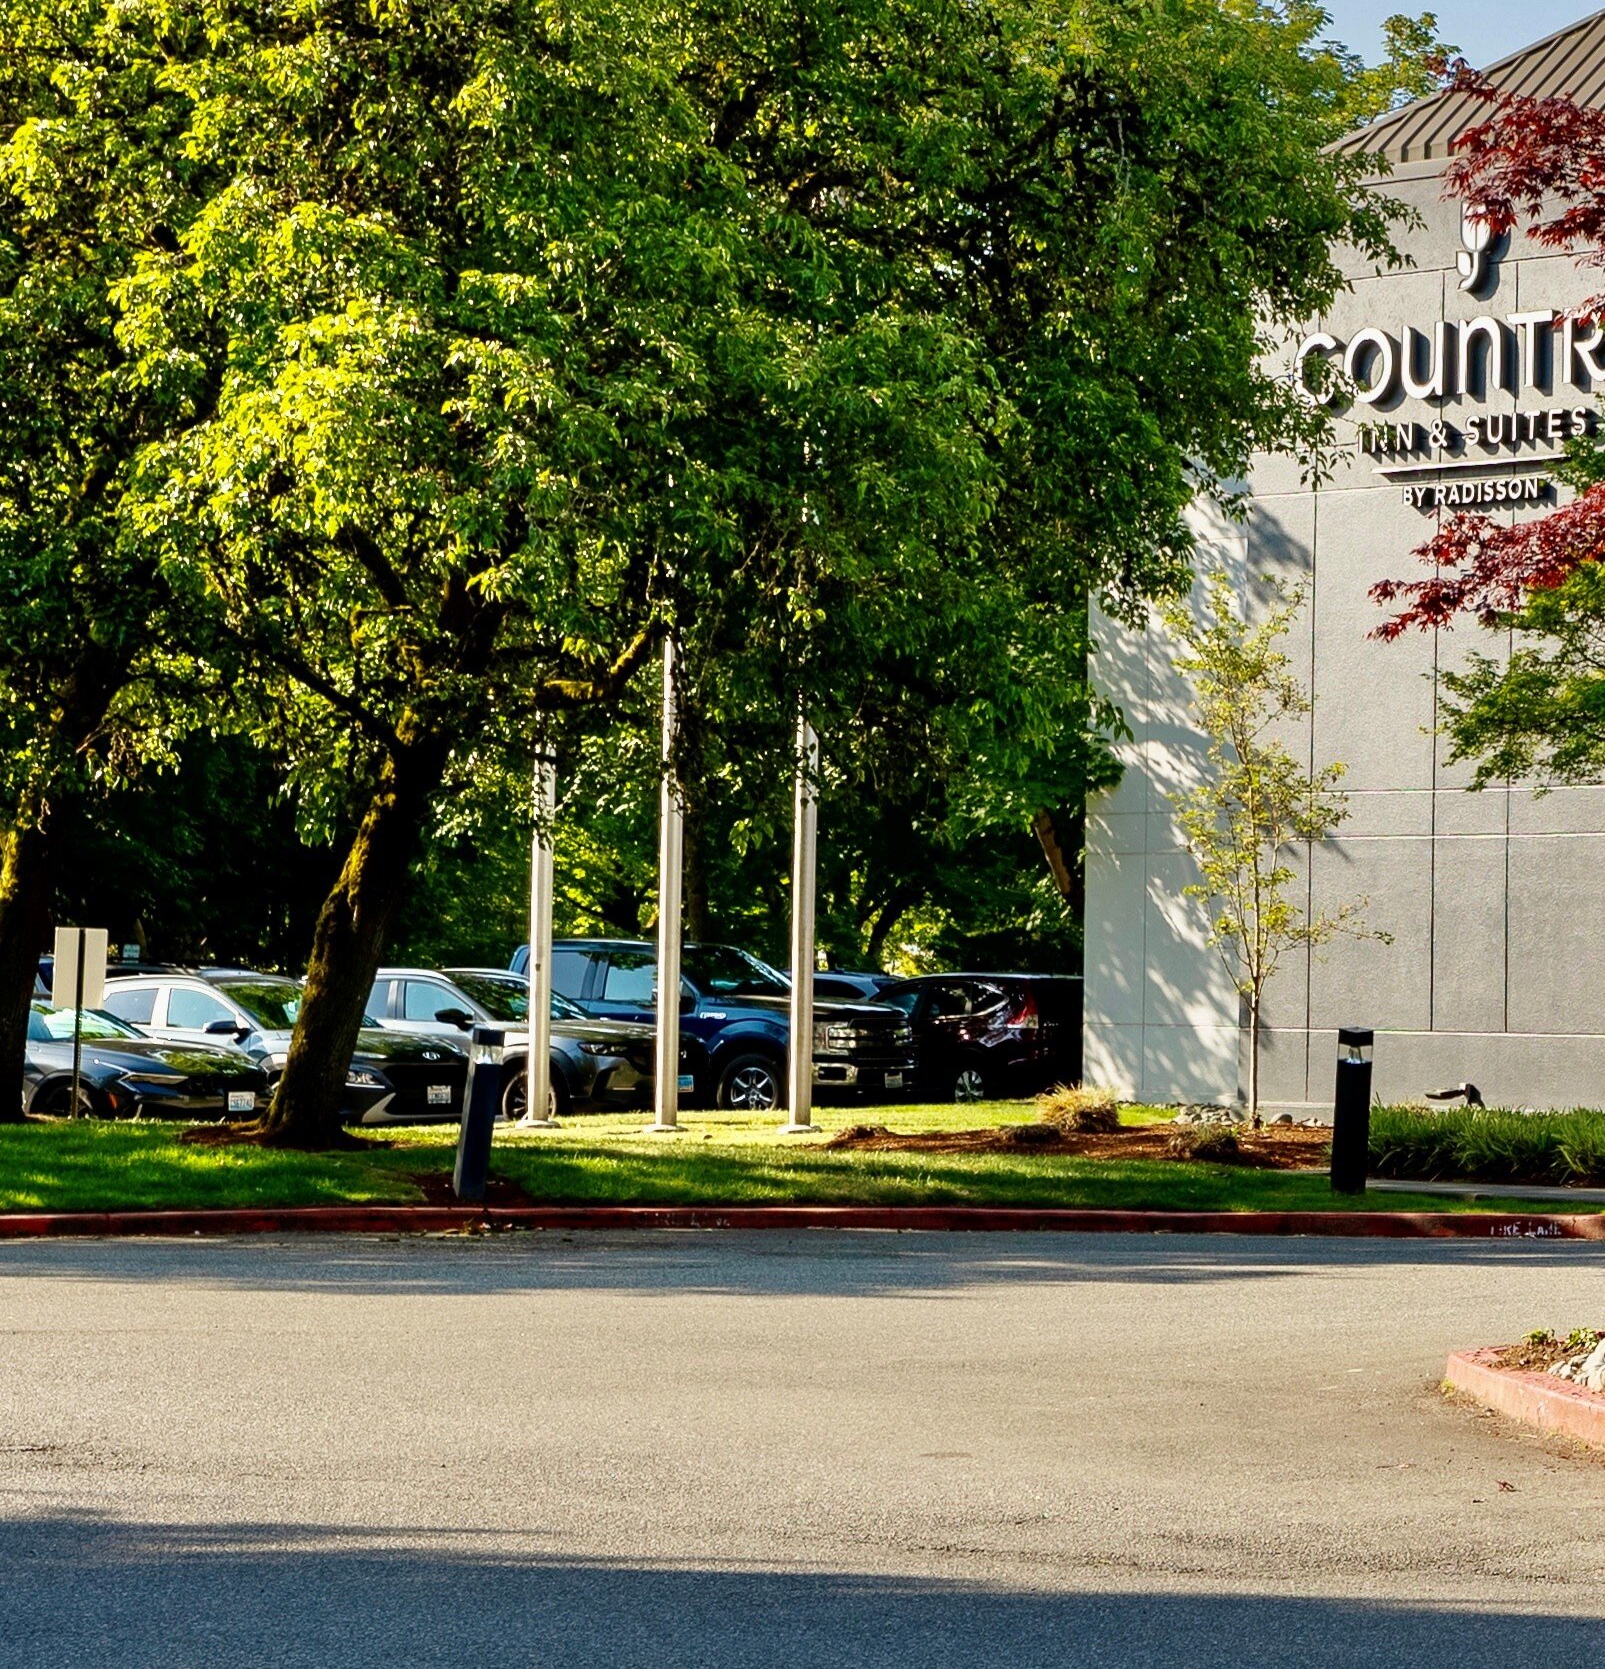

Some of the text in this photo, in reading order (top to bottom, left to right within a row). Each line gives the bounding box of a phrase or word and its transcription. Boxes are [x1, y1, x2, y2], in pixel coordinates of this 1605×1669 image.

[1358, 405, 1587, 454] INN & SUITES
[1403, 478, 1538, 507] BY RADISSON
